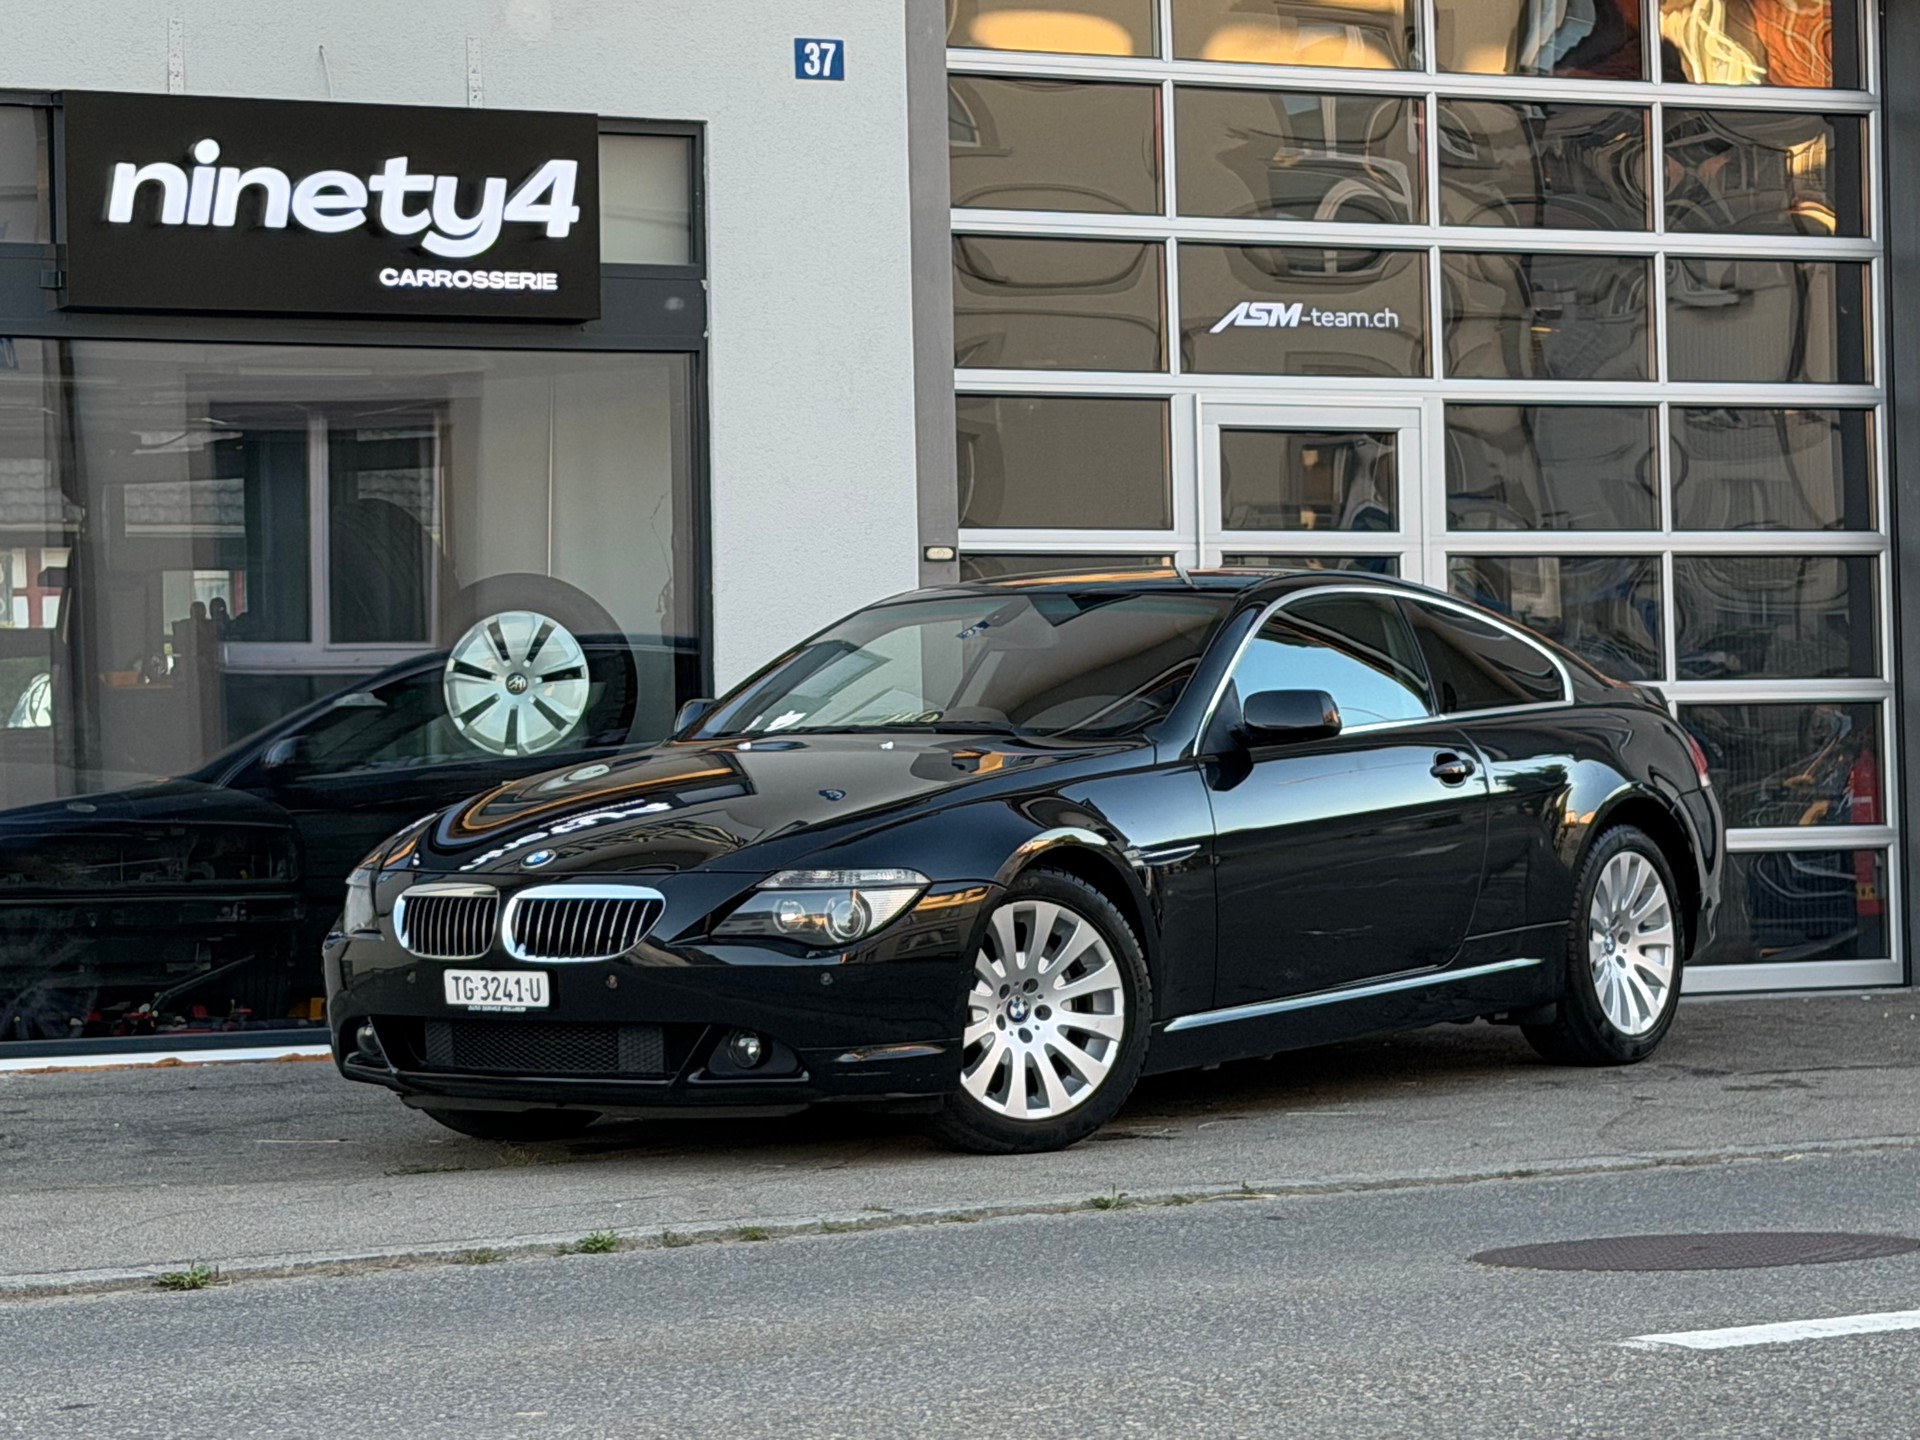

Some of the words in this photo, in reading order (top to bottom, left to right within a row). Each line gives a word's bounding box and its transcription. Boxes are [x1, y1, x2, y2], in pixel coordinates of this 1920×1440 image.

[804, 42, 836, 77] 37
[107, 138, 580, 258] ninety4
[379, 267, 558, 291] CARROSSERIE
[1209, 301, 1399, 333] ASM-team.ch
